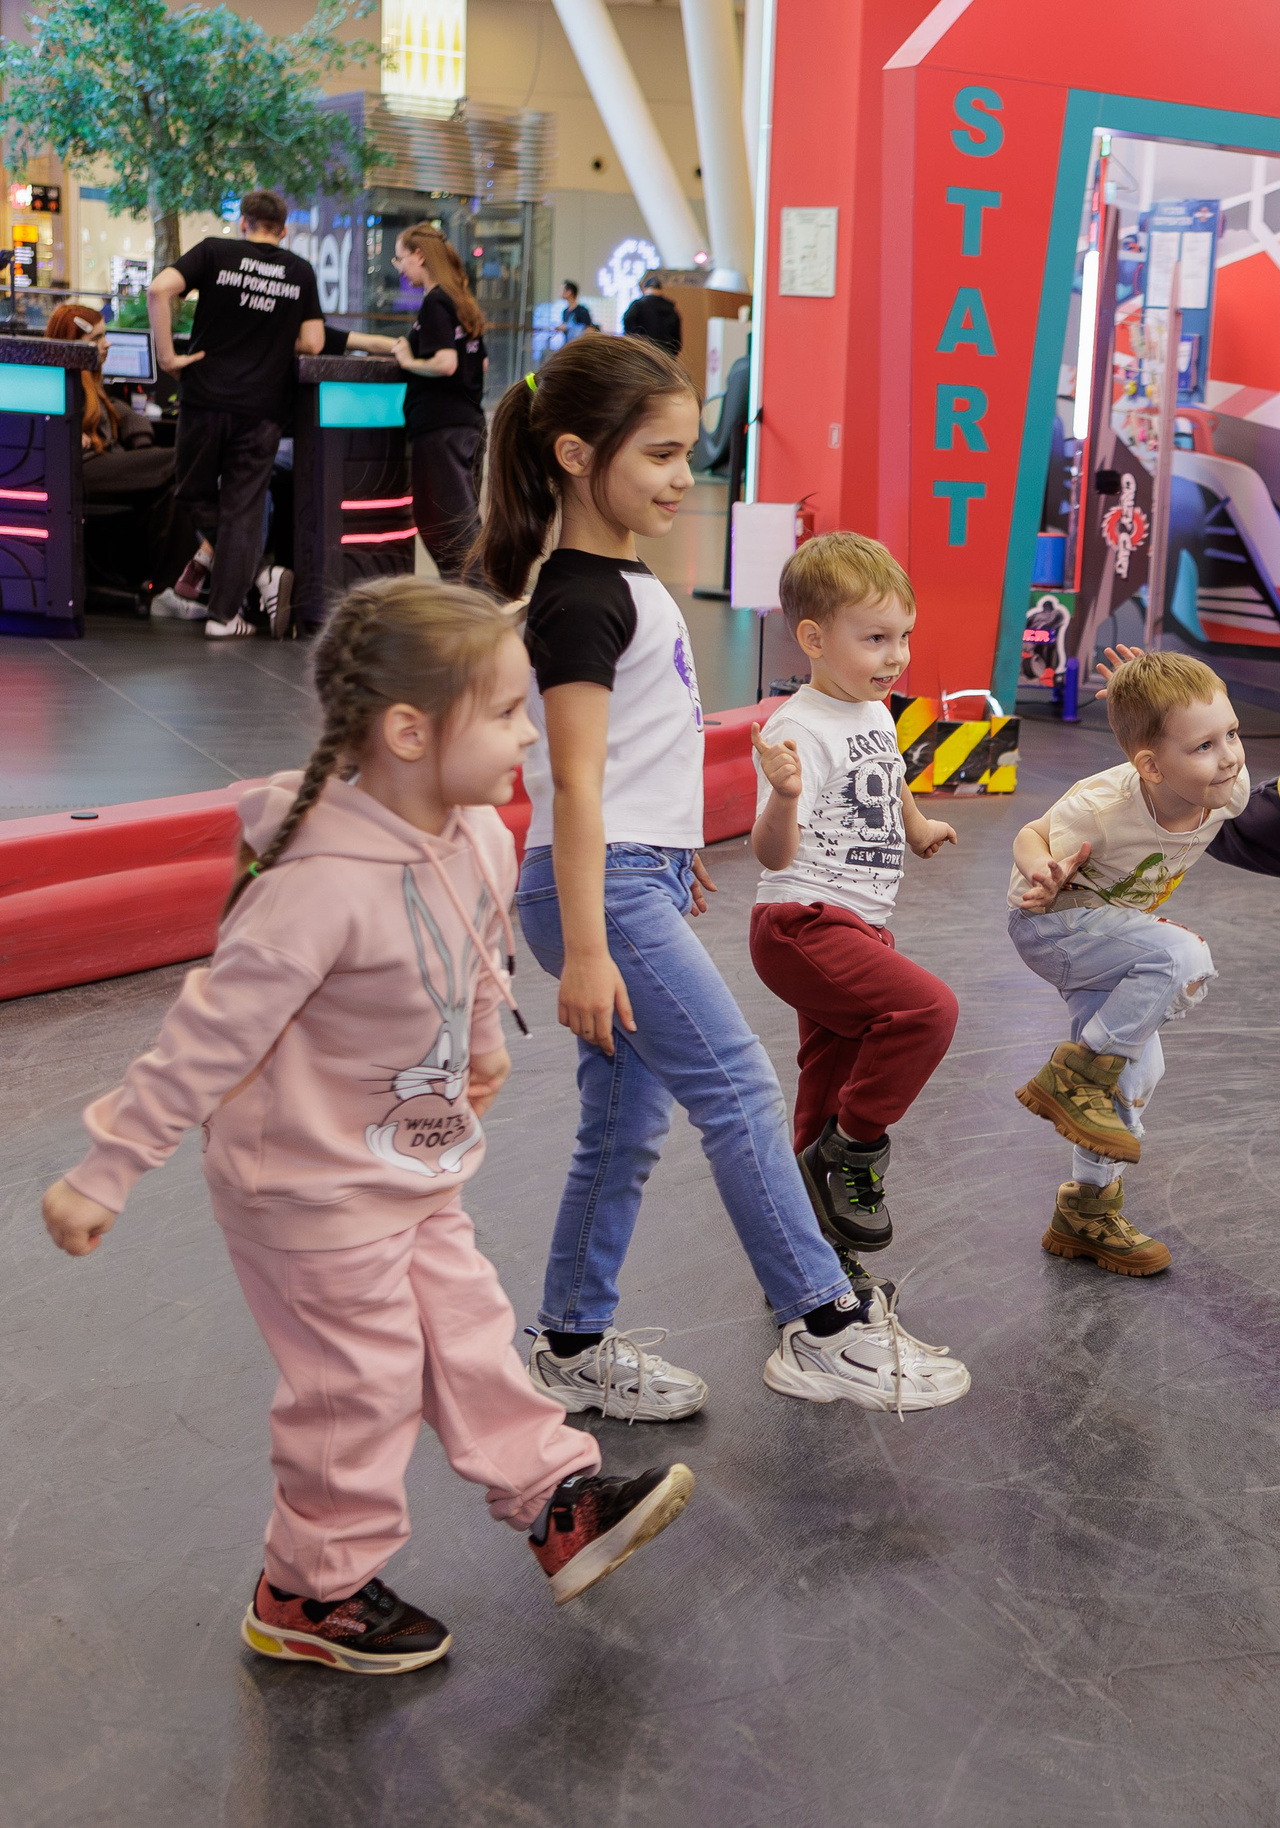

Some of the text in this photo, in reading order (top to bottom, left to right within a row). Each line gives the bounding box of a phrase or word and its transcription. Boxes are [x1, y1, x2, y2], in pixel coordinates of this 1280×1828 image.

[216, 269, 243, 287] ДНИ
[239, 257, 286, 280] ЛУЧШИЕ
[239, 291, 250, 307] У
[932, 85, 1005, 547] START
[850, 849, 901, 866] NEW YORK
[409, 1125, 467, 1148] DOC?
